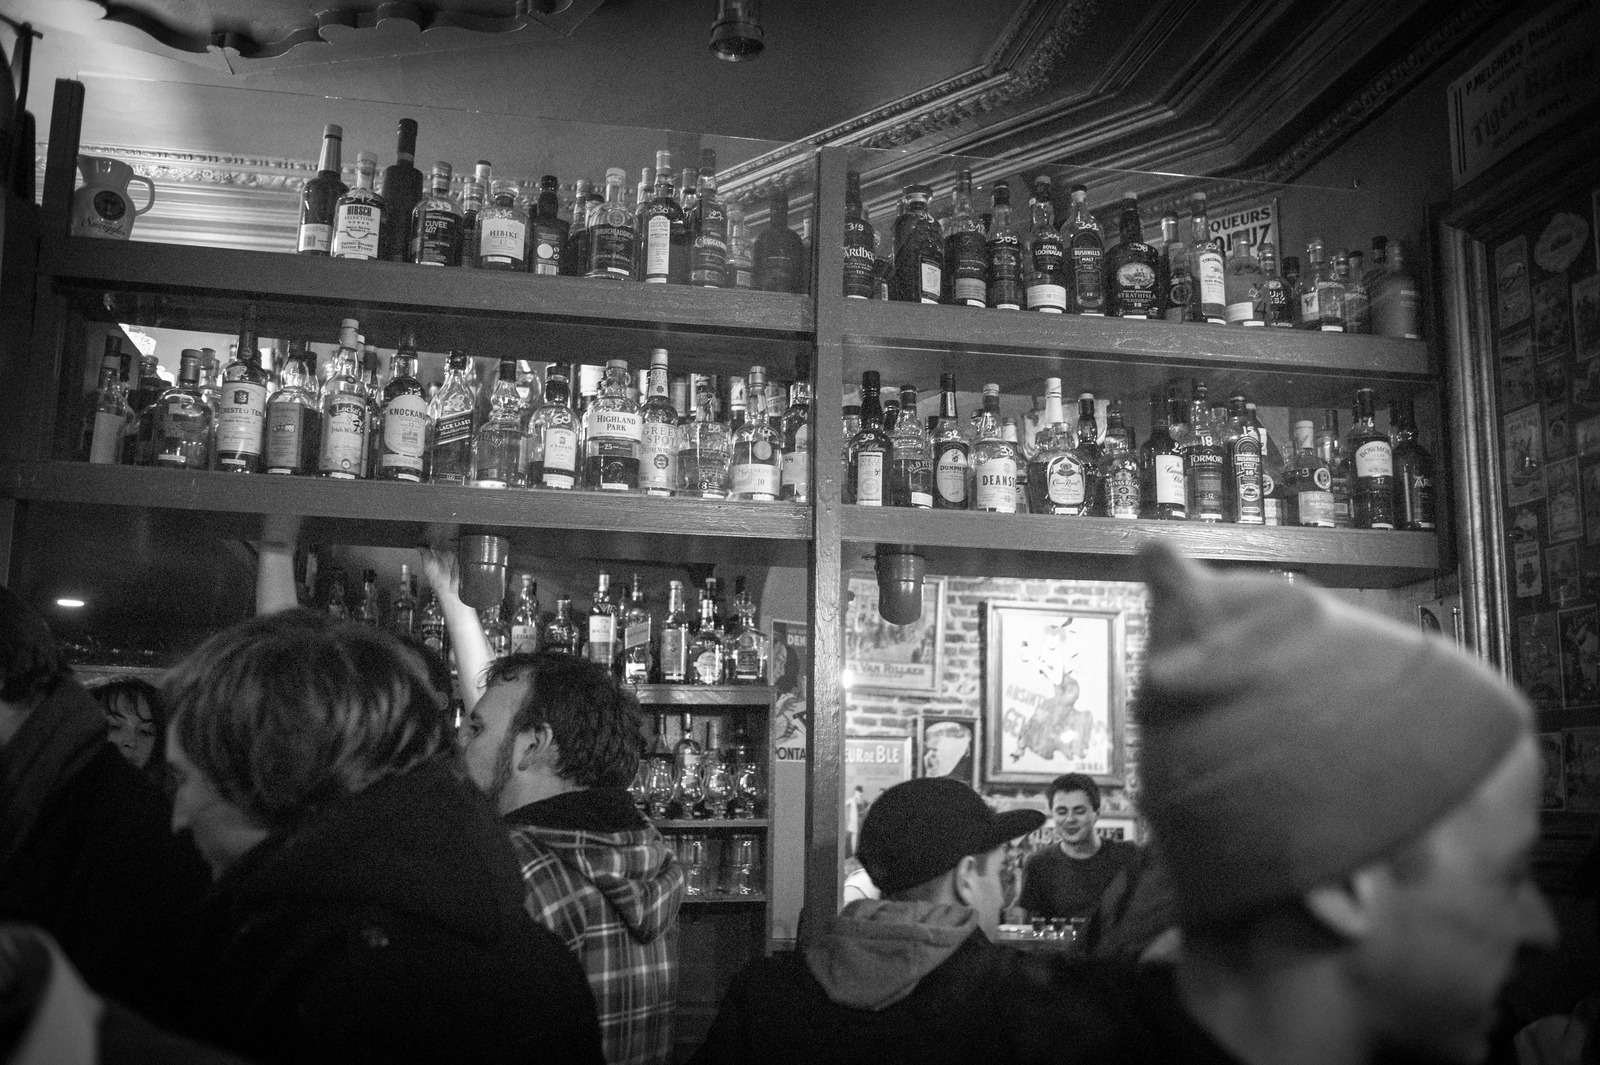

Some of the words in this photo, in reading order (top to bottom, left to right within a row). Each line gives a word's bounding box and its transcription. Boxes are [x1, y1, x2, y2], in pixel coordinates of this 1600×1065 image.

[347, 206, 372, 217] HIRSCH
[425, 220, 448, 230] CUVEE
[490, 230, 518, 239] HIBIKI
[1117, 292, 1157, 300] STRATHISLA
[389, 408, 429, 421] KNOCKAN
[454, 420, 471, 429] LABEL
[596, 415, 636, 426] HIGHLAND
[606, 423, 627, 432] PARK
[647, 435, 675, 446] SPOT
[1200, 435, 1213, 447] 18
[775, 747, 806, 761] ONTA
